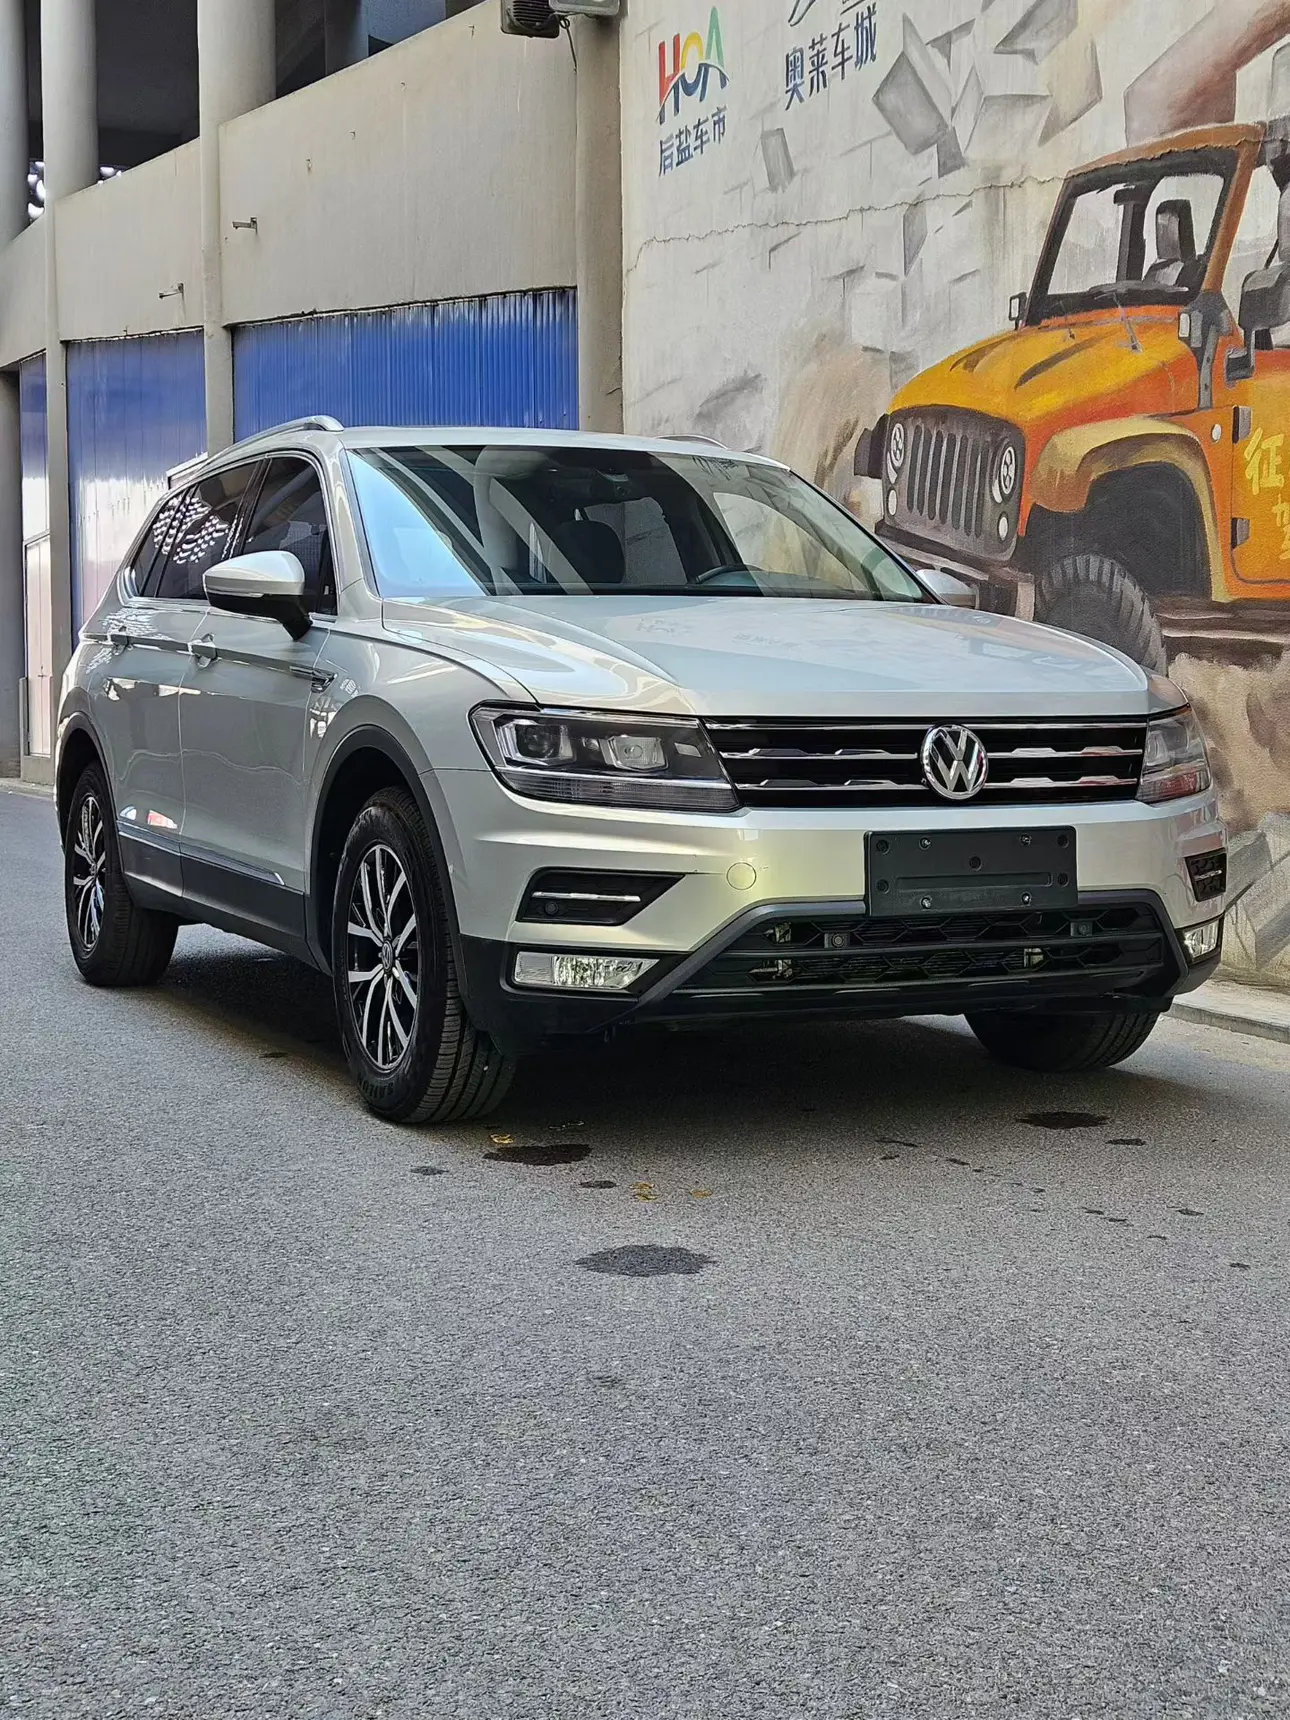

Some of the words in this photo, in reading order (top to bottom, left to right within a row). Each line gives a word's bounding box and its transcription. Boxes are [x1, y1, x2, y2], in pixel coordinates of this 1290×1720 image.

[657, 6, 729, 125] HOA
[785, 2, 877, 111] 奥莱车城
